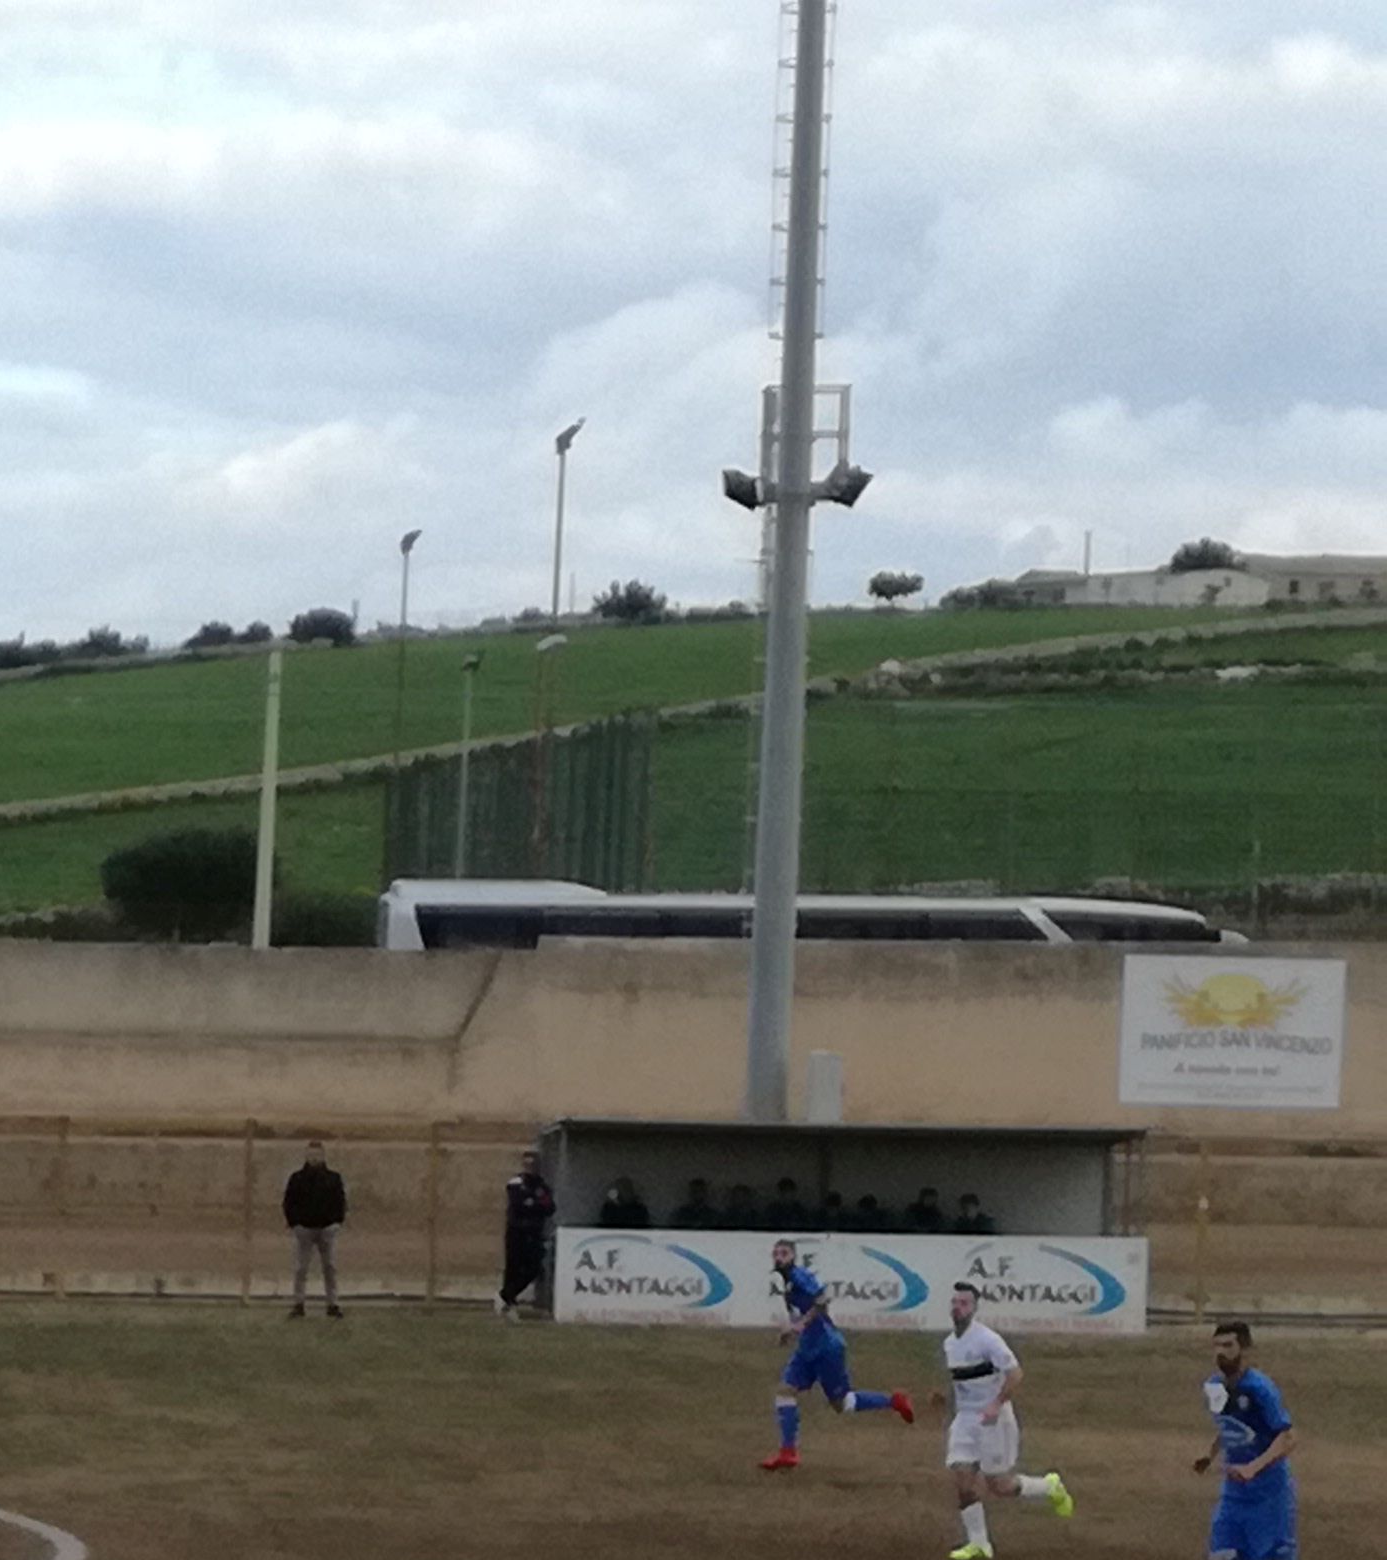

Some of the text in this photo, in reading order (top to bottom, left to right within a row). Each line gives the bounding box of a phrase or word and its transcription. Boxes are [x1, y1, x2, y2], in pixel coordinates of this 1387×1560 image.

[1141, 1031, 1333, 1055] PANIFICIO SAN VINCENZO
[574, 1248, 623, 1271] A.F.
[966, 1255, 1015, 1279] A.F.
[573, 1276, 704, 1297] MONTAGGI
